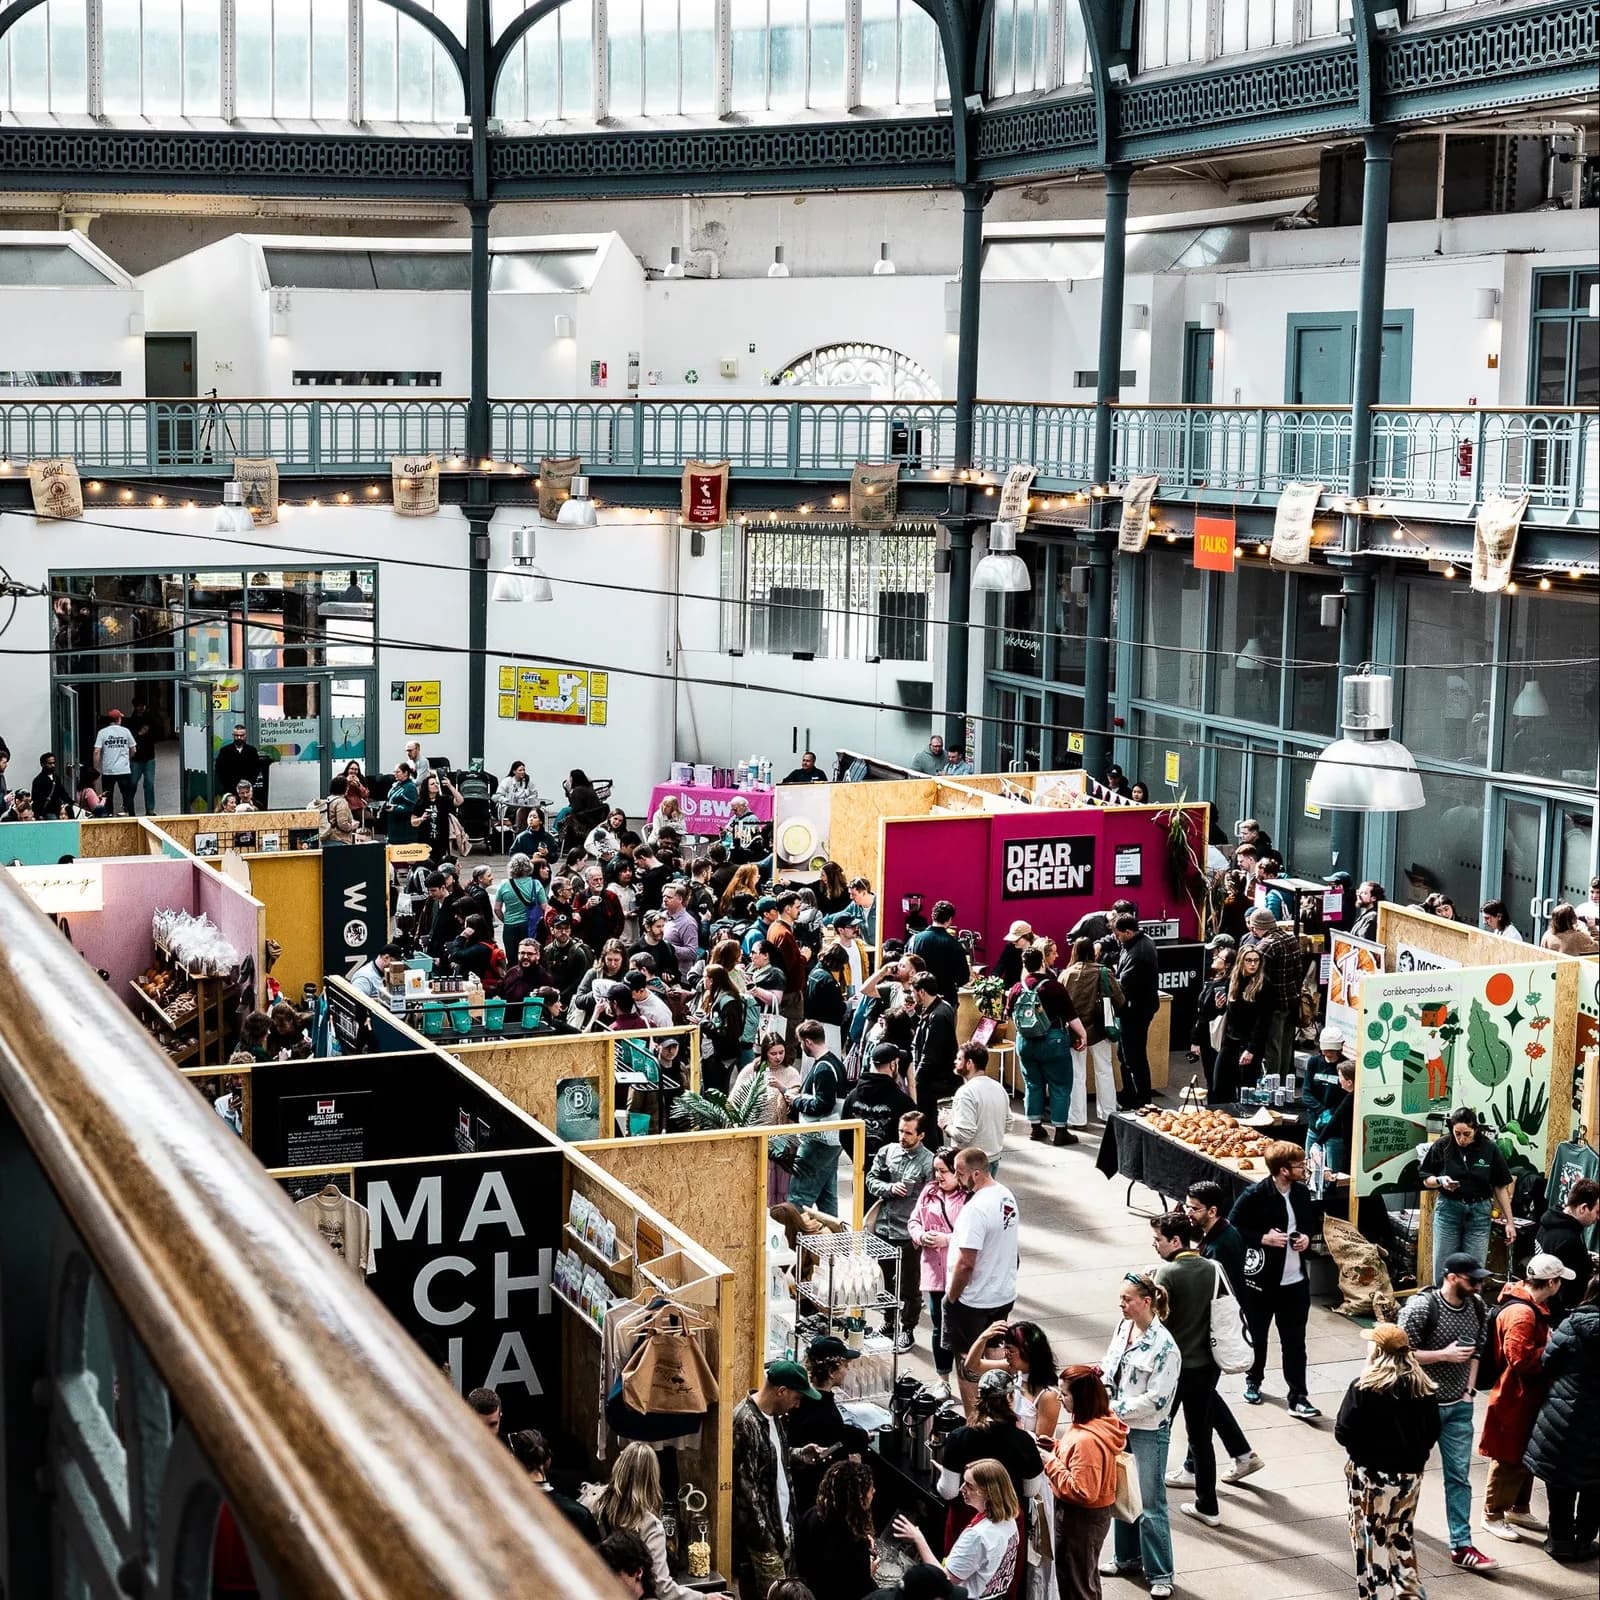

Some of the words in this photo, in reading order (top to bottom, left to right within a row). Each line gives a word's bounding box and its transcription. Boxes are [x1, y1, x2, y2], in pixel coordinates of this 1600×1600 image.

[1199, 535, 1228, 554] TALKS
[408, 685, 422, 693] CUP
[407, 712, 422, 720] CUP
[407, 722, 423, 730] HIRE
[1007, 843, 1072, 869] DEAR
[573, 1091, 584, 1108] B
[325, 1112, 344, 1120] COFFEE
[367, 1171, 526, 1249] MA
[413, 1248, 552, 1326] CH
